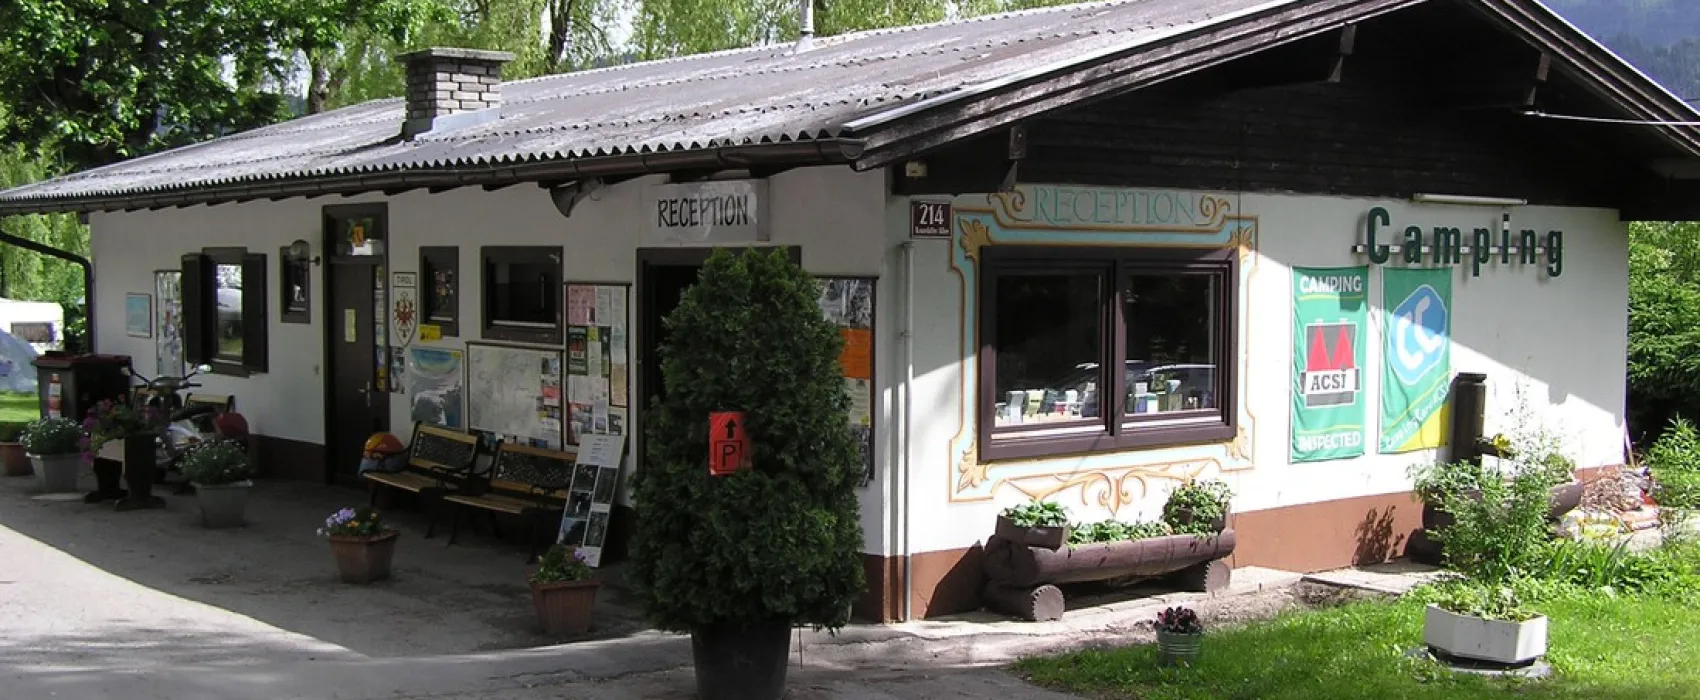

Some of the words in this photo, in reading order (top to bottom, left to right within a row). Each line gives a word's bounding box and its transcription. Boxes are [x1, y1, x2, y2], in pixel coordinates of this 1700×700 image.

[658, 194, 748, 228] RECEPTION
[919, 204, 945, 225] 214
[1032, 186, 1197, 227] RECEPTION
[1367, 207, 1563, 277] Camping
[1300, 275, 1363, 293] CAMPING
[1298, 431, 1362, 450] INSPECTED
[722, 444, 737, 468] P
